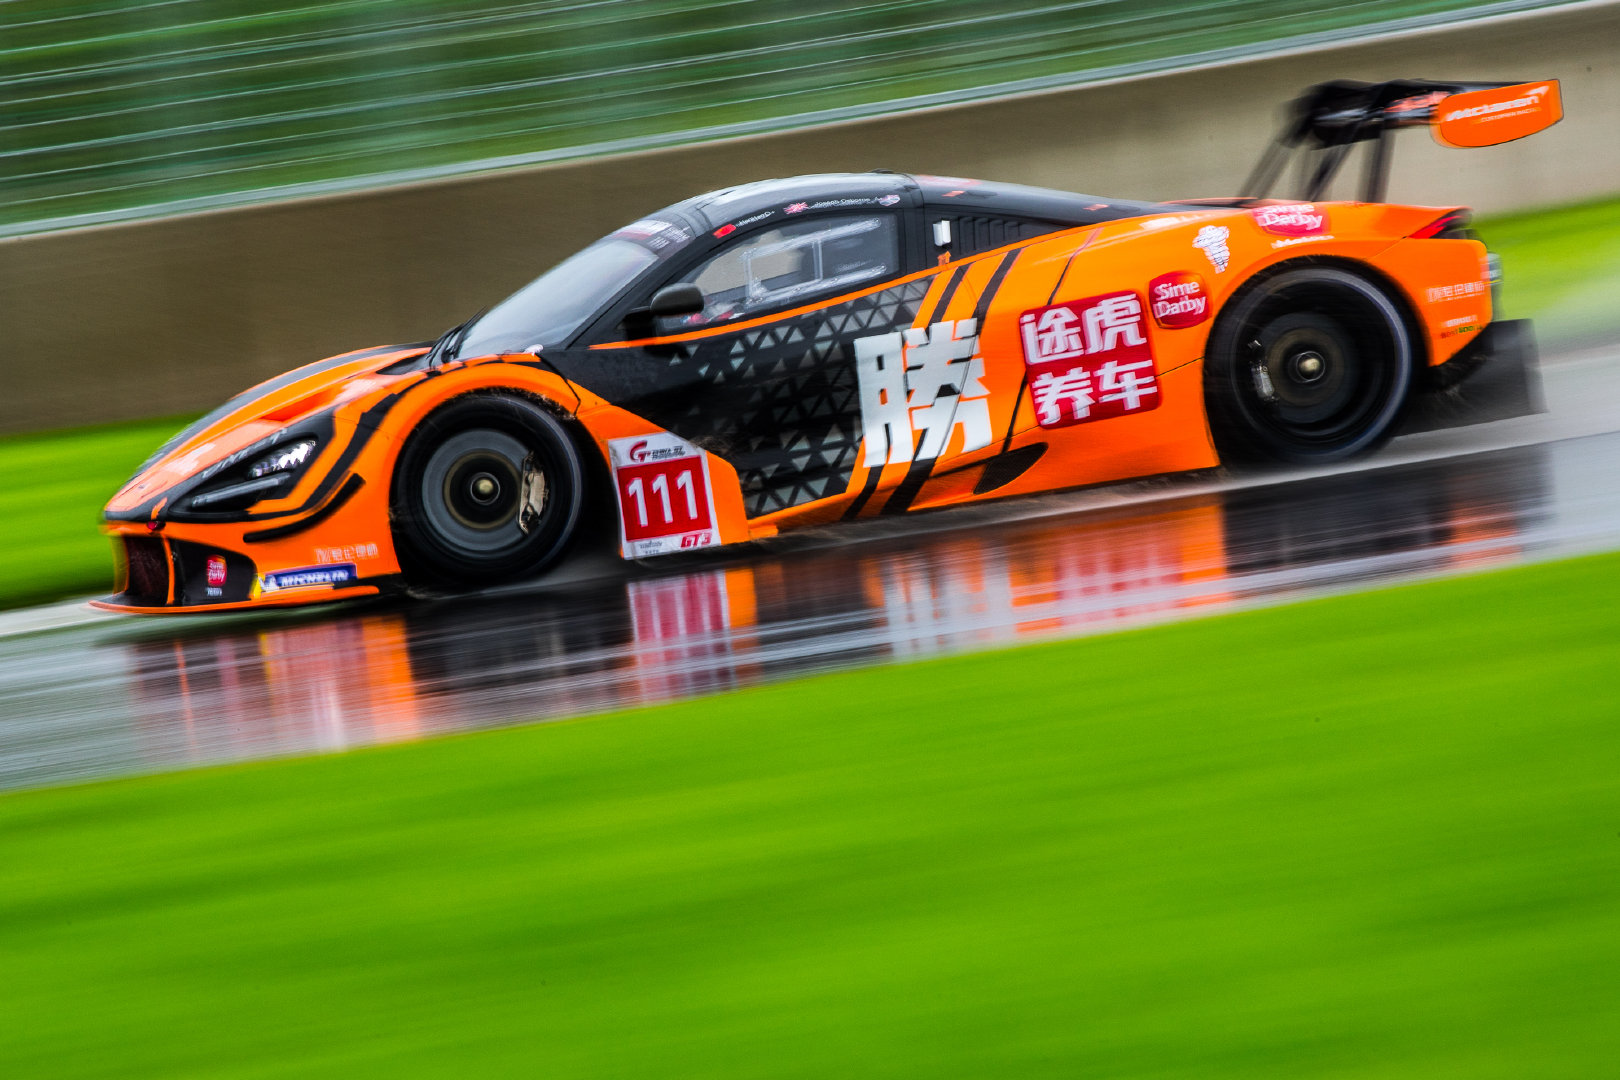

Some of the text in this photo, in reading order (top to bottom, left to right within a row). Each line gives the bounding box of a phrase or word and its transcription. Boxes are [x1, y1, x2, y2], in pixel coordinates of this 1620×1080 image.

[1256, 204, 1315, 215] Sime
[1257, 211, 1323, 231] Darby
[1155, 280, 1200, 301] Sime
[1154, 294, 1206, 318] Darby
[1020, 292, 1147, 365] 途虎
[853, 317, 992, 468] 勝
[1032, 359, 1158, 425] 养车
[627, 469, 698, 528] 111
[680, 532, 713, 549] GT3
